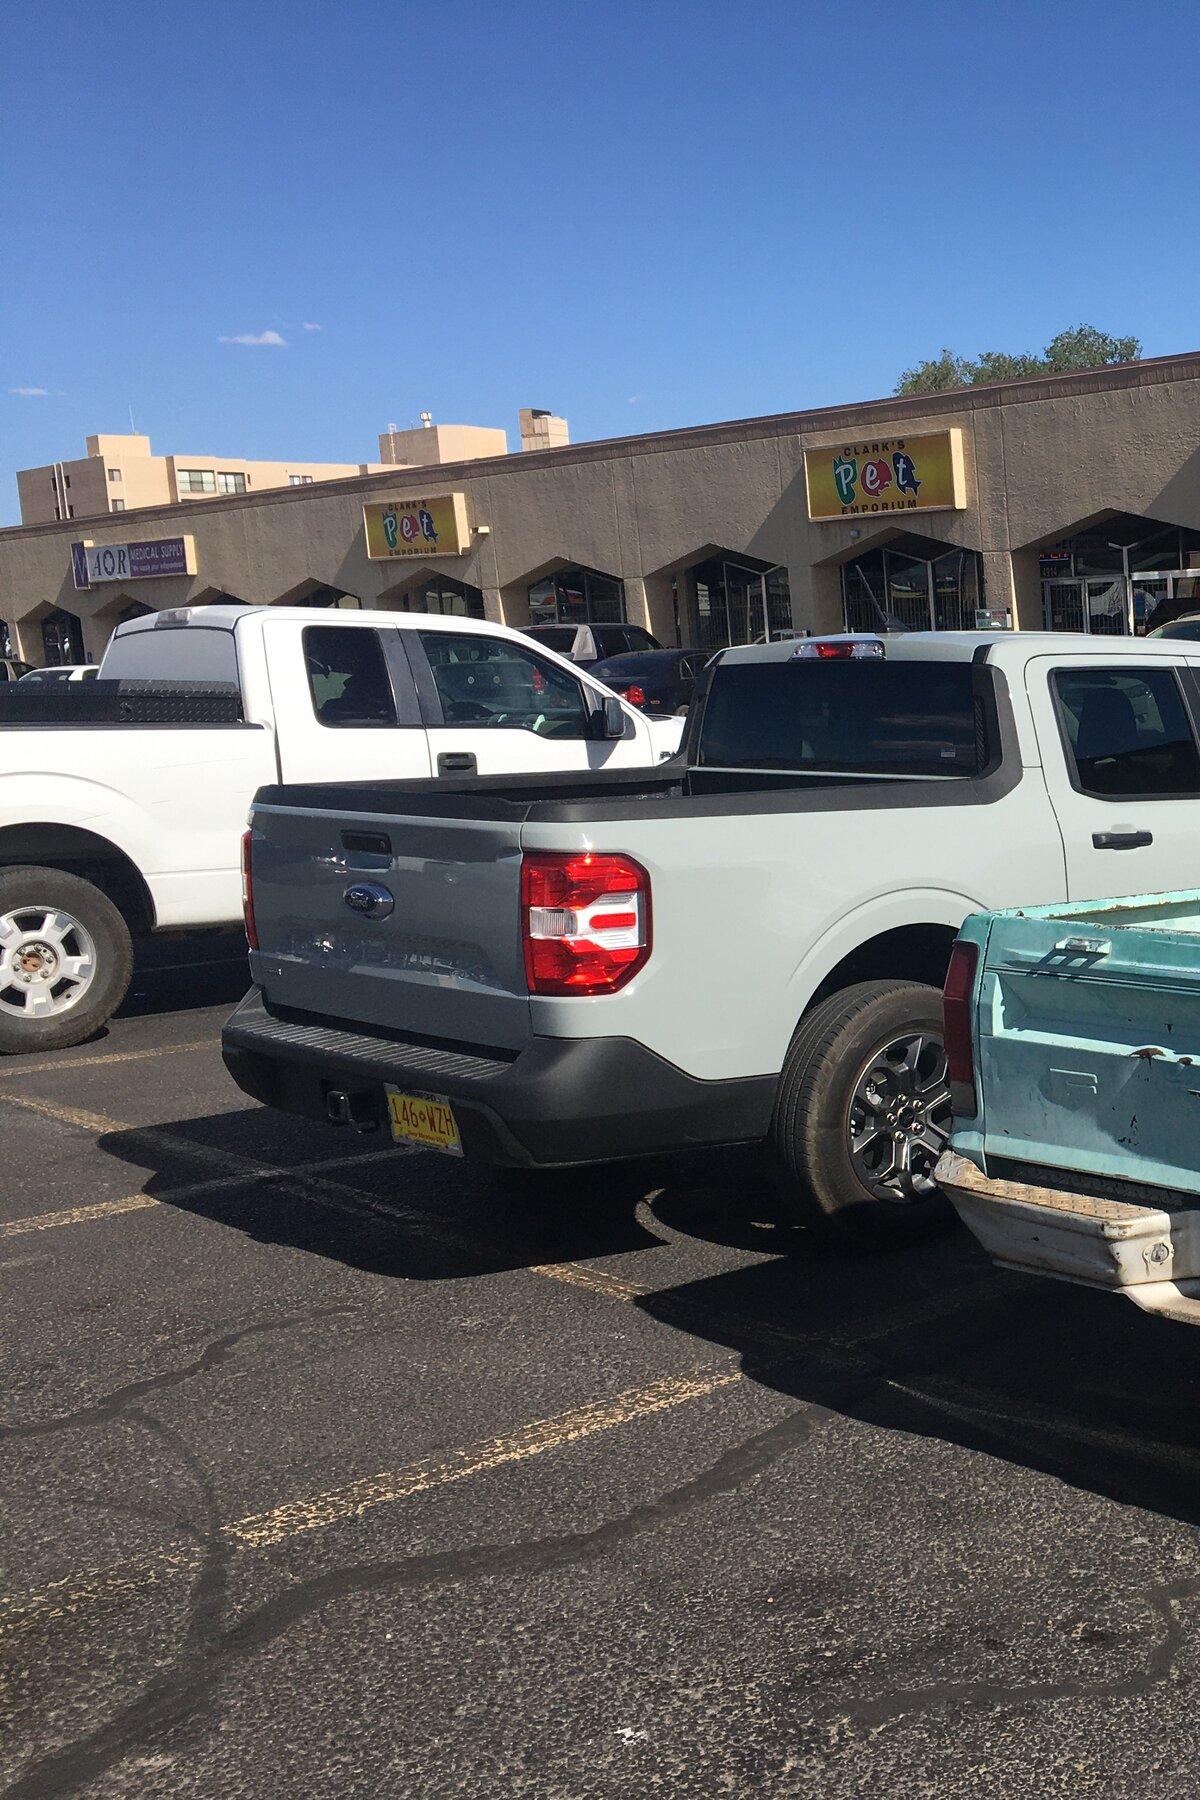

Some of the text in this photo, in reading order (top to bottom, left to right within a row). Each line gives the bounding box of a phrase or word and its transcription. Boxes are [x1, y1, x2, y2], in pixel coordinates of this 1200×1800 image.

[844, 439, 906, 457] CLARK'S
[834, 455, 915, 500] Pet
[388, 500, 427, 511] CLARK'S
[841, 500, 917, 515] EMPORIUM
[383, 511, 433, 544] Pet
[130, 544, 184, 560] MEDICAL SUPPLY
[389, 547, 437, 556] EMPORIUM
[92, 549, 127, 577] AOR
